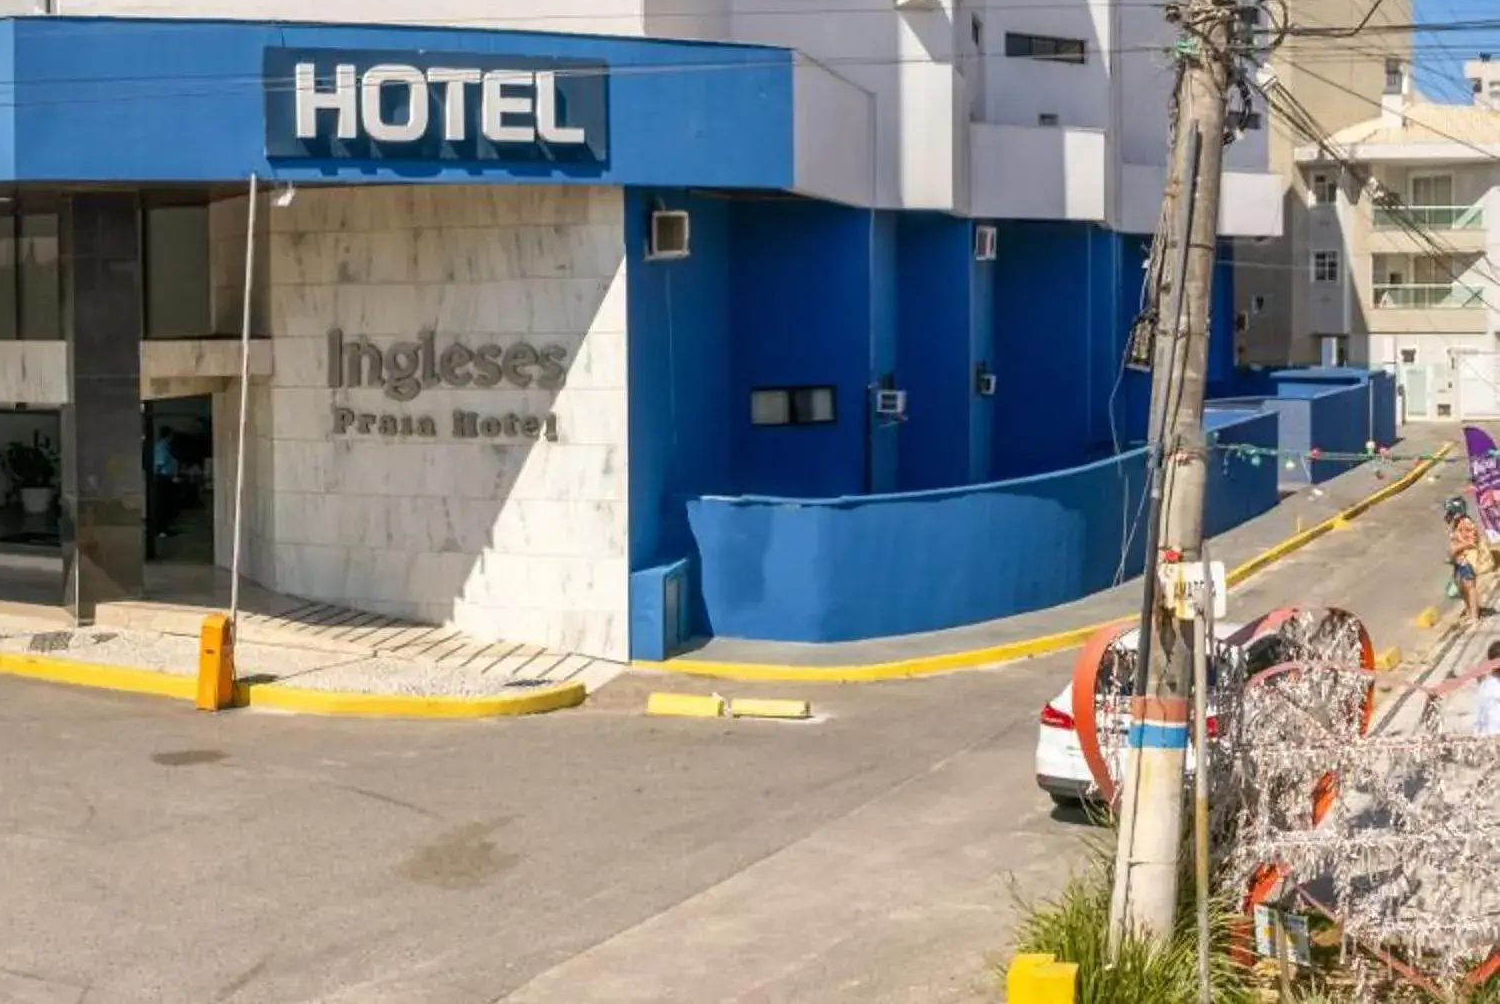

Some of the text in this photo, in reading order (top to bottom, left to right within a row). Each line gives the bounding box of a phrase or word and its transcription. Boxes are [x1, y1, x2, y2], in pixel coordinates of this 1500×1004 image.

[295, 62, 585, 144] HOTEL
[326, 326, 568, 402] Ingleses
[331, 406, 558, 443] Praia Hotel
